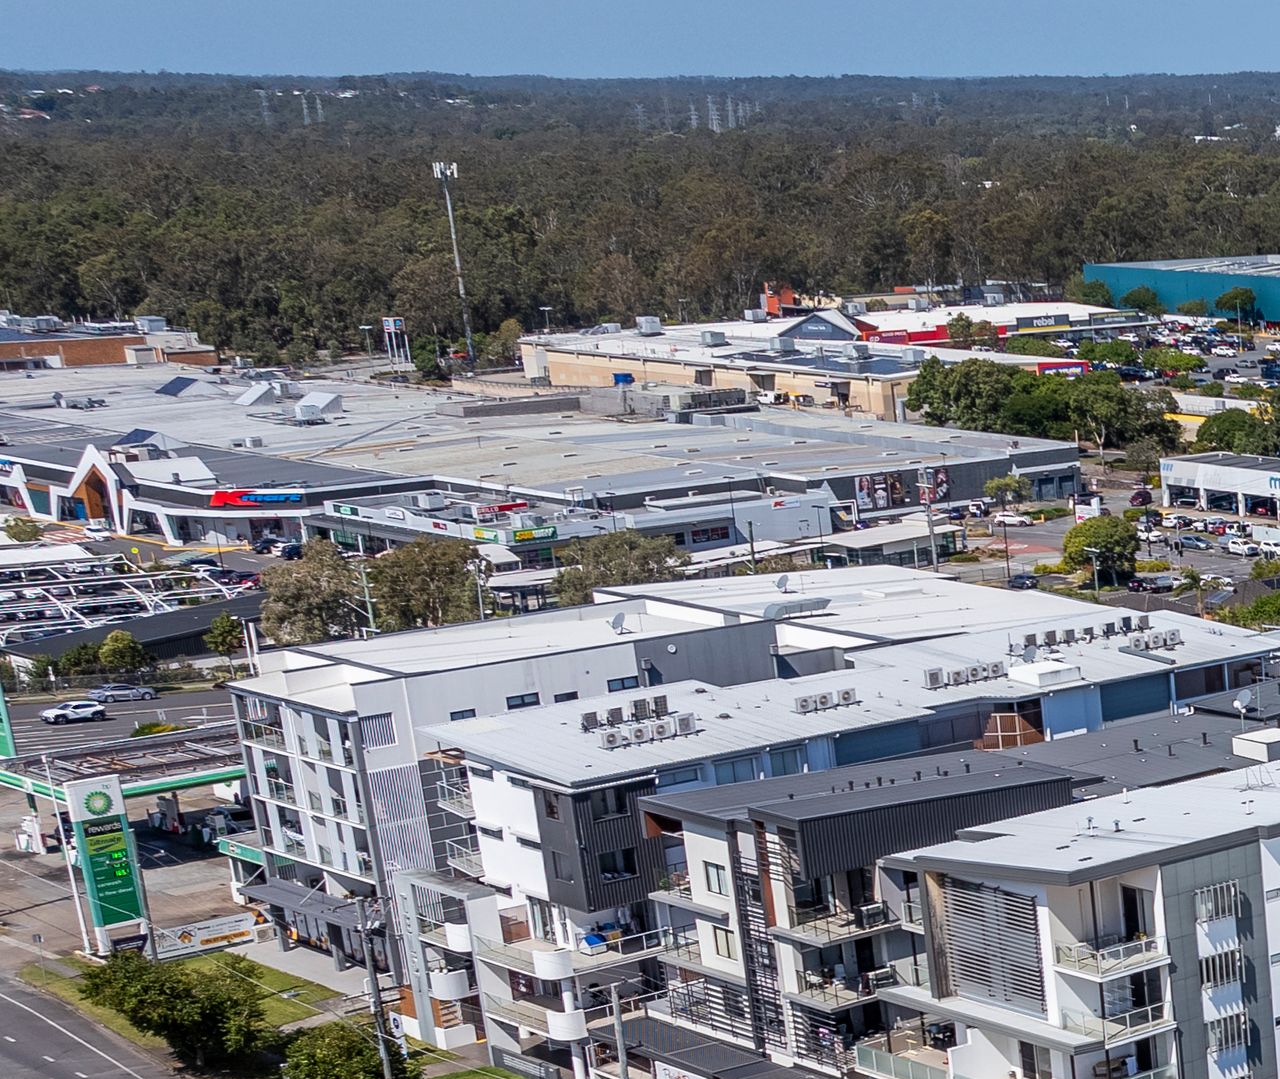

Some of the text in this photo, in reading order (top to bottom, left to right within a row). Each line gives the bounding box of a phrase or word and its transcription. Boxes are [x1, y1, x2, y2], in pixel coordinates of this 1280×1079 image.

[1033, 316, 1055, 327] rebel
[209, 490, 302, 507] Kmart
[87, 821, 122, 834] rewards
